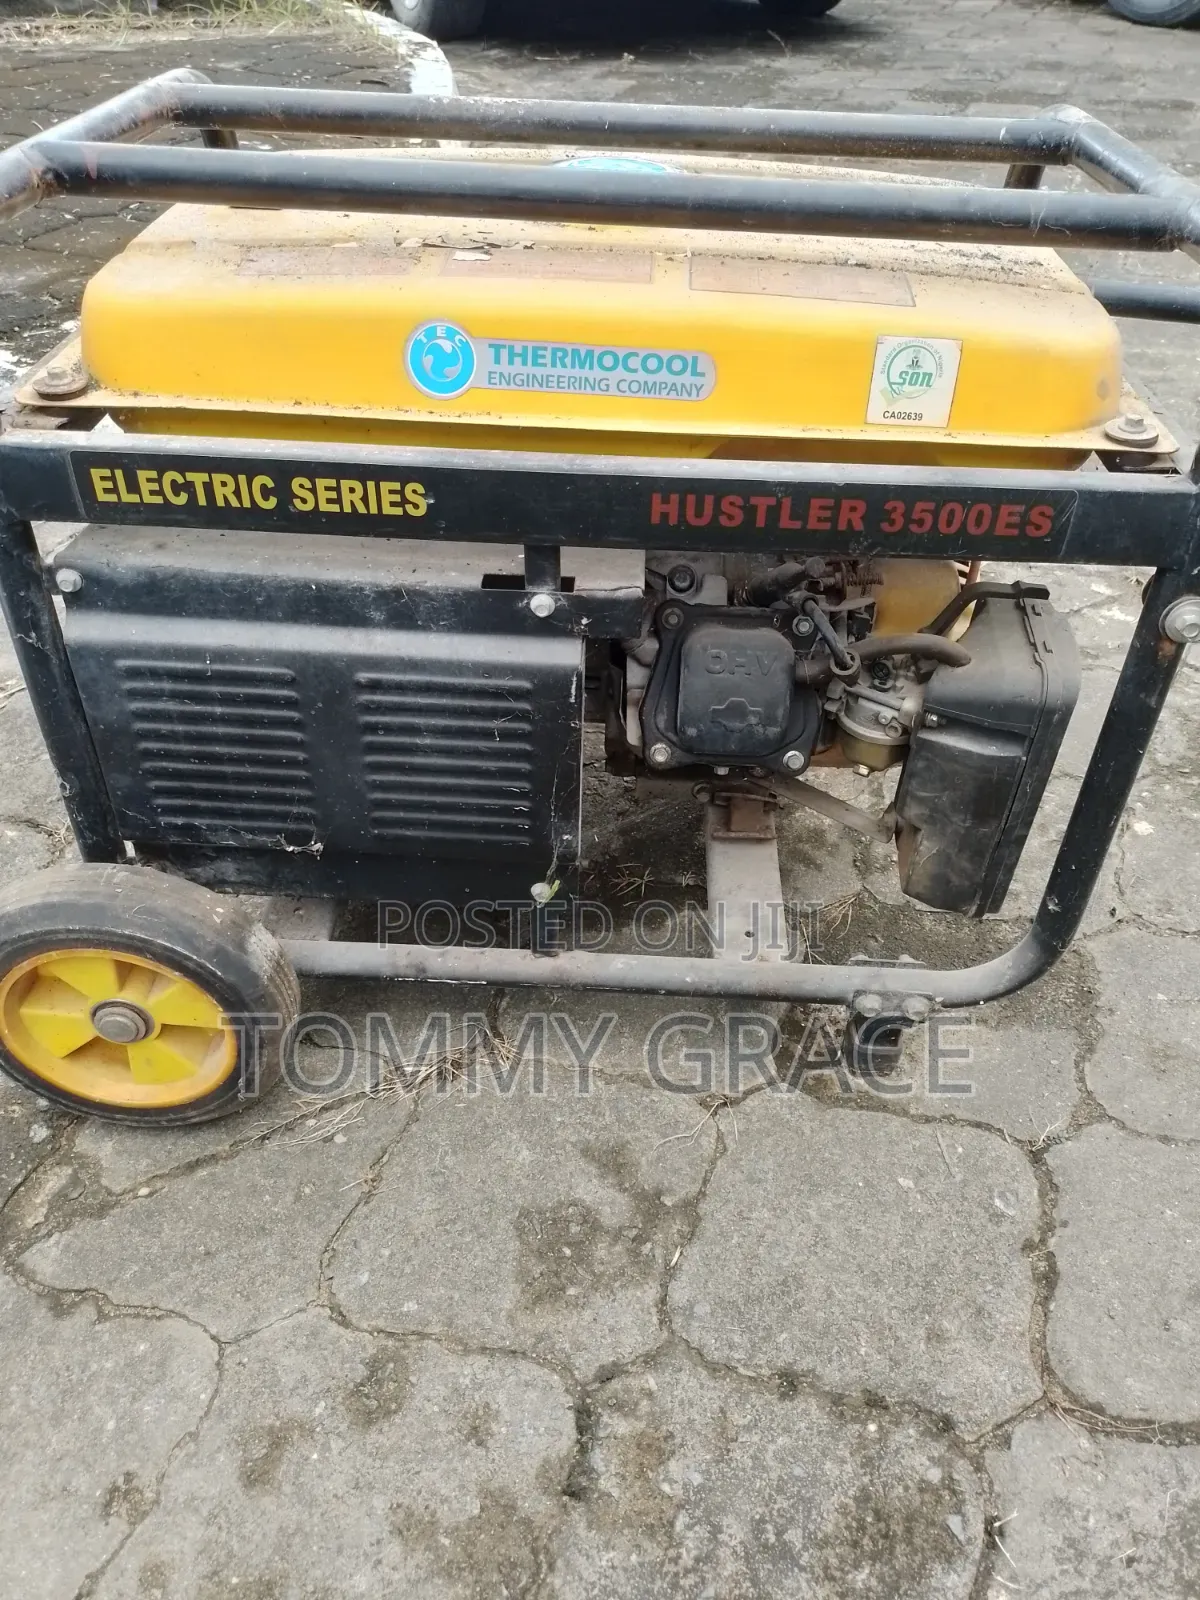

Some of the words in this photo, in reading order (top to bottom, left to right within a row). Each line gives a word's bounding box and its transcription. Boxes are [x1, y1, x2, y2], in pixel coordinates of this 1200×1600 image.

[416, 325, 467, 347] TEC
[487, 343, 706, 377] THERMOCOOL
[487, 371, 610, 393] ENGINEERING
[616, 378, 705, 398] COMPANY
[883, 410, 923, 421] CA02639
[89, 467, 277, 510] ELECTRIC
[290, 475, 428, 518] SERIES
[650, 492, 867, 532] HUSTLER
[880, 500, 1054, 539] 3500ES
